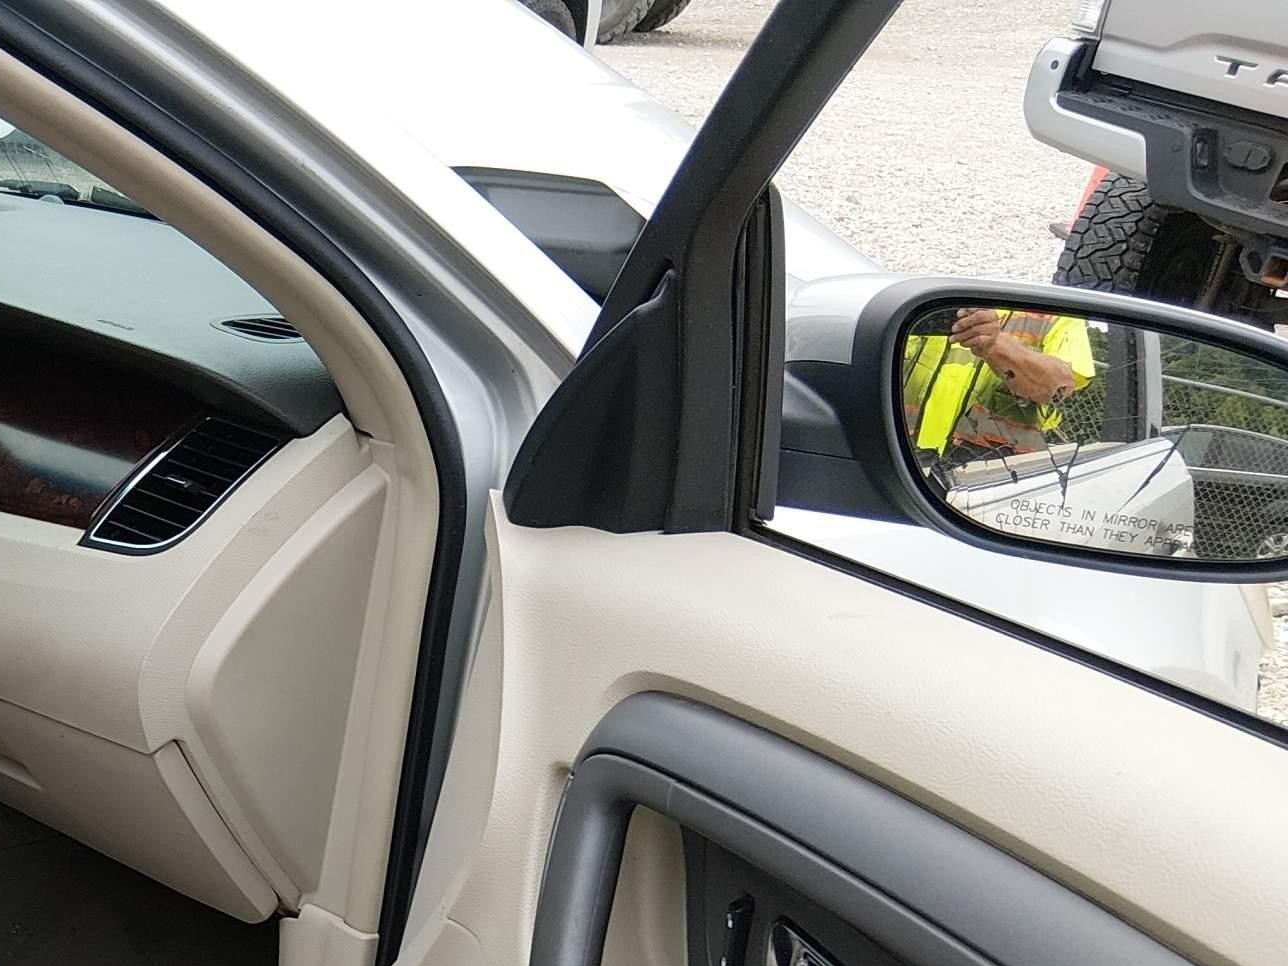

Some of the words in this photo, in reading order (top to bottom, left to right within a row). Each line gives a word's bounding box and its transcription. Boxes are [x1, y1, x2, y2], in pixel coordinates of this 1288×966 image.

[995, 512, 1050, 530] CLOSER
[1059, 521, 1095, 537] THAN
[1103, 527, 1139, 543] THEY
[1010, 499, 1072, 518] OBJECTS
[1081, 509, 1096, 521] IN
[1103, 512, 1158, 531] MIRROR
[1164, 523, 1193, 538] ARE
